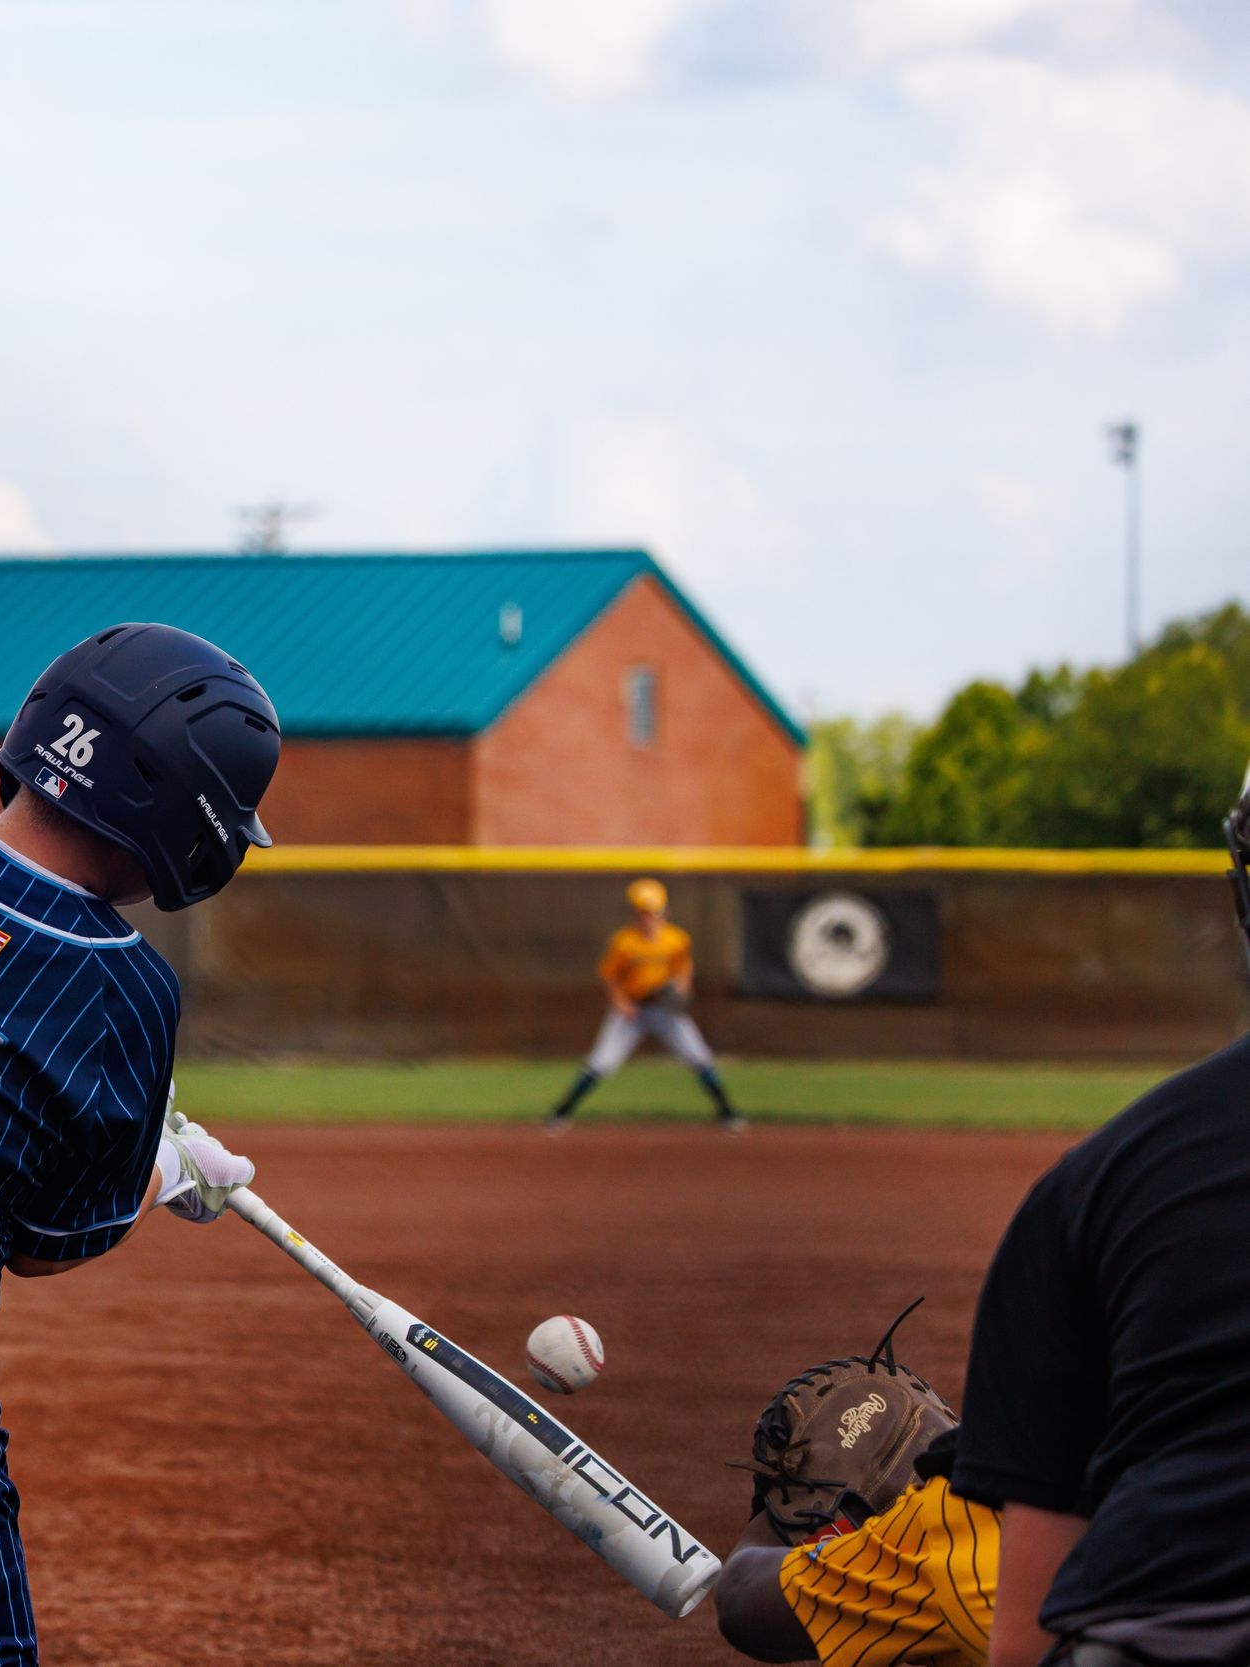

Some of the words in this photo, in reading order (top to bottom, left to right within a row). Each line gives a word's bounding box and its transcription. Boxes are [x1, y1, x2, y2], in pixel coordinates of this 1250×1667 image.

[34, 743, 95, 789] RAWLINGS
[50, 713, 102, 768] 26
[197, 793, 229, 844] RAWLINGS
[837, 1393, 887, 1449] Rawlings
